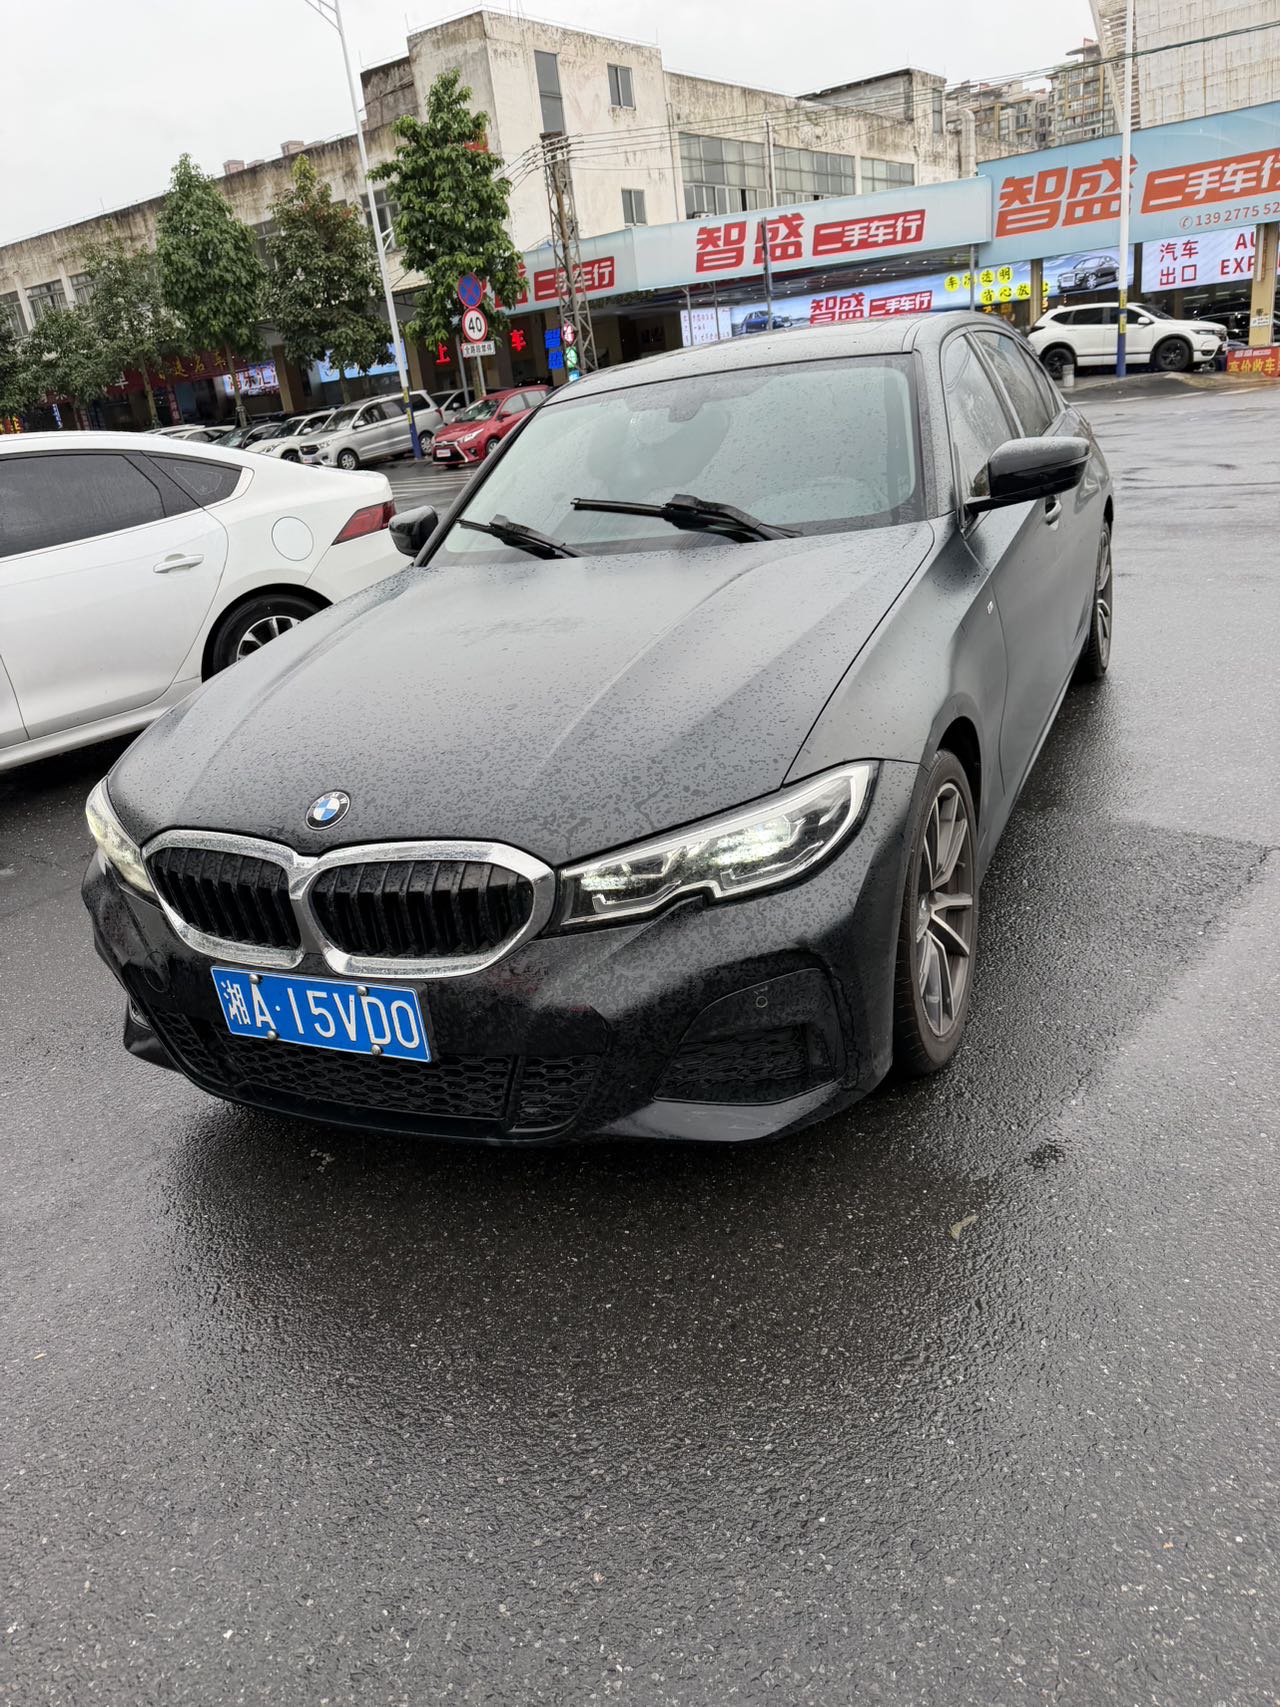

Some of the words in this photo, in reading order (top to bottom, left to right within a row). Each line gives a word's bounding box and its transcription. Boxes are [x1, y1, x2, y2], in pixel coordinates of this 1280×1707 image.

[995, 154, 1139, 238] 智盛
[1195, 211, 1221, 227] 139
[1223, 204, 1259, 222] 2775
[695, 212, 805, 273] 智盛
[815, 214, 922, 252] 二手车行
[1159, 239, 1200, 263] 汽车
[1159, 263, 1198, 286] 出口
[809, 291, 866, 325] 智盛
[870, 293, 933, 315] 二手车行
[468, 316, 482, 333] 40
